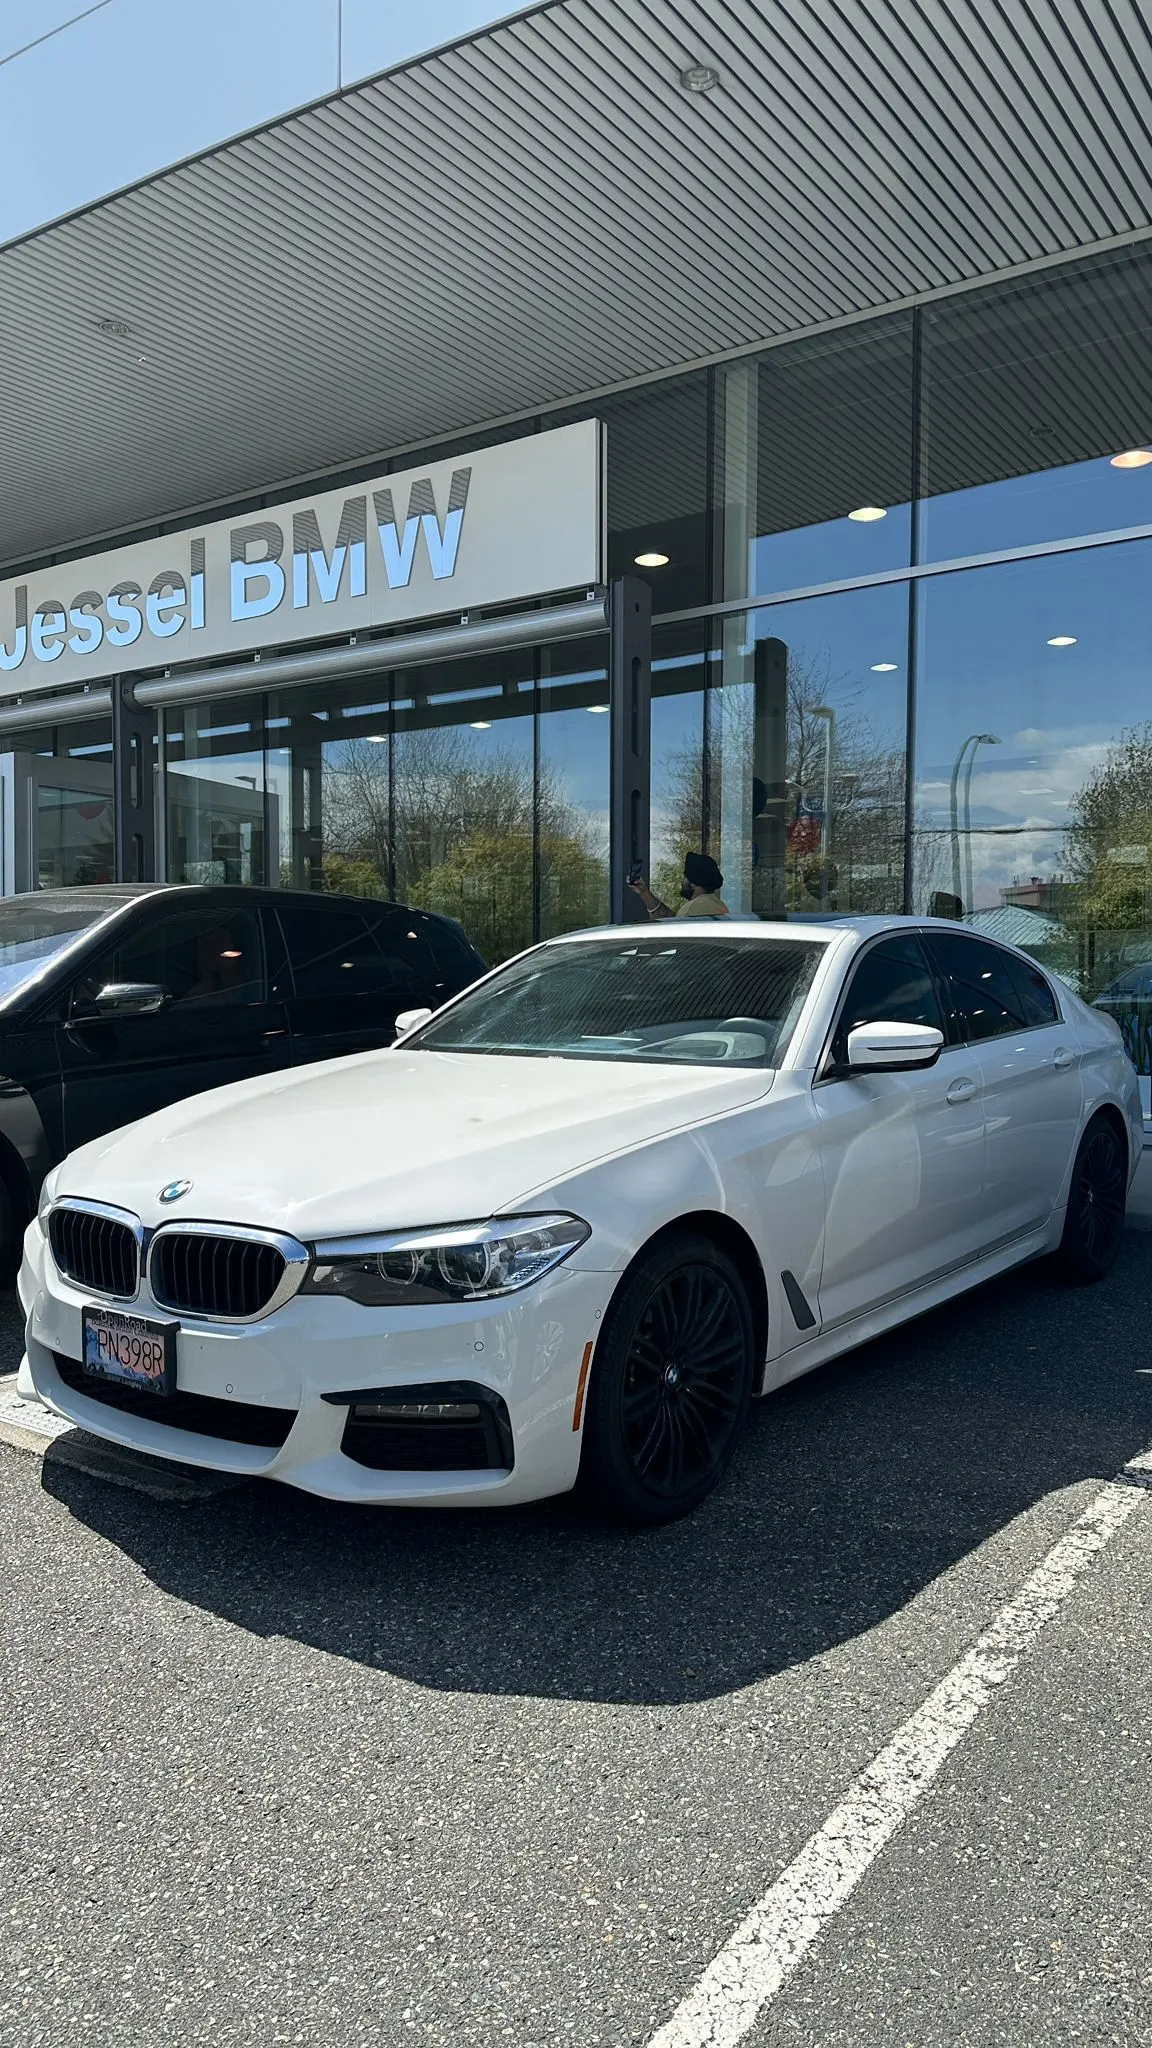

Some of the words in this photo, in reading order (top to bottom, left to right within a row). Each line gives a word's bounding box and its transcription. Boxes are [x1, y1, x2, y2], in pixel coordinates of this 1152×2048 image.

[0, 537, 206, 671] Jessel
[230, 467, 472, 622] BMW
[100, 1310, 148, 1333] OpenRoad
